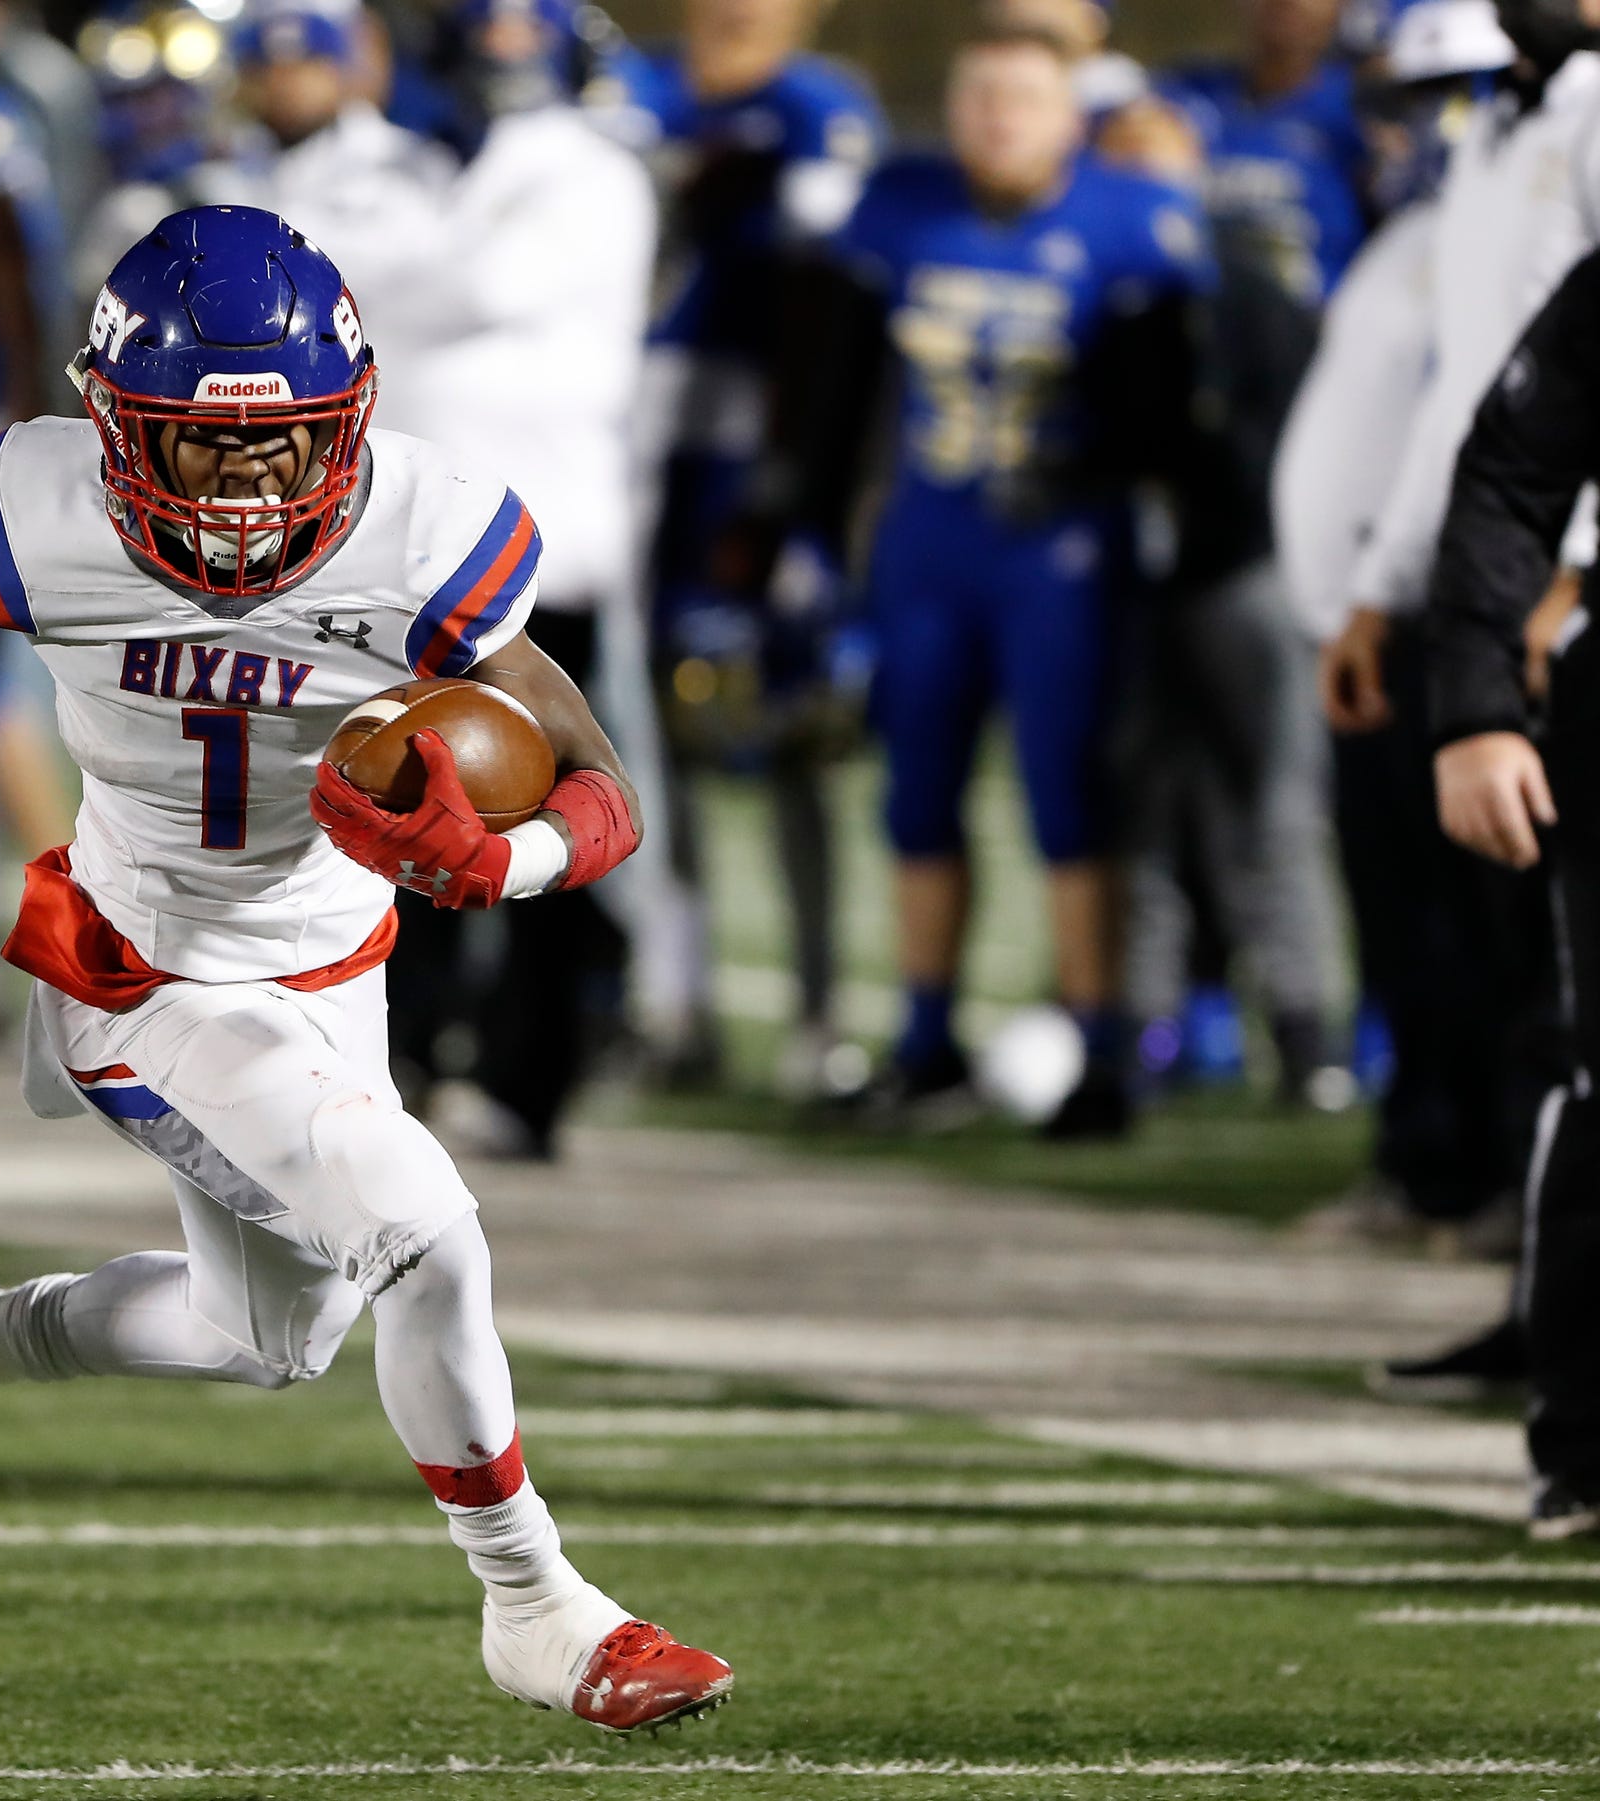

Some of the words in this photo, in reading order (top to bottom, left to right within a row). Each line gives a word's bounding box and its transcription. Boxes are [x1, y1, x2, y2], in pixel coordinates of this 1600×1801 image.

[207, 381, 280, 396] Riddell
[213, 551, 251, 560] Riddll
[119, 638, 315, 708] BIXBY
[181, 706, 249, 850] 1
